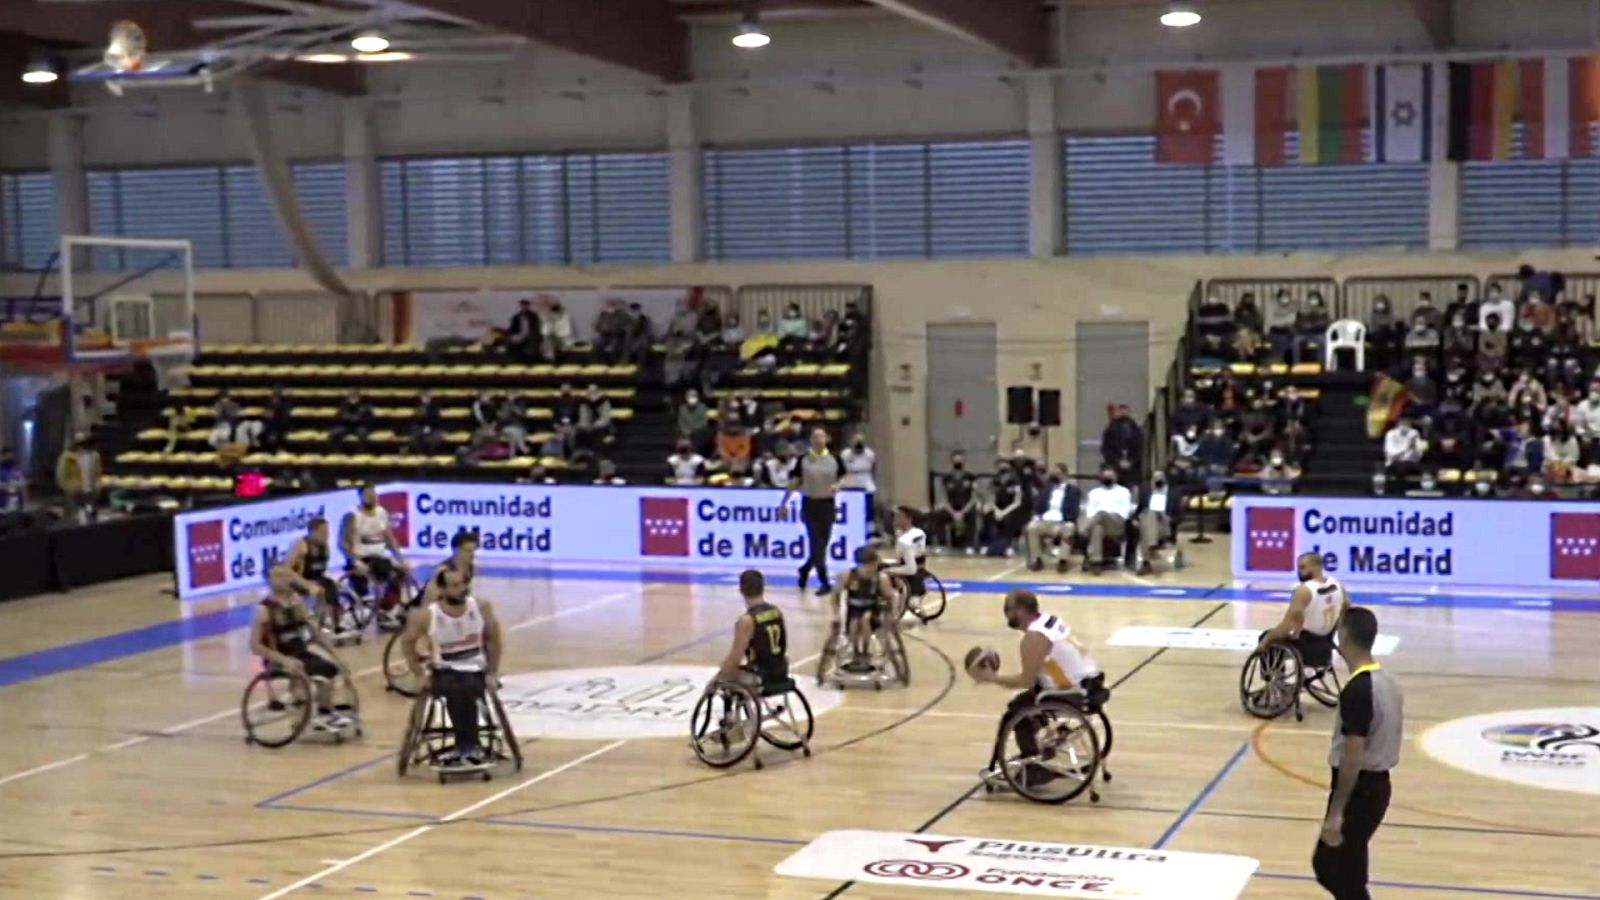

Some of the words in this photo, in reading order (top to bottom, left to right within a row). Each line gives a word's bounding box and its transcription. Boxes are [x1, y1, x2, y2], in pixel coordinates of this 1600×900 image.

[416, 493, 551, 517] Comunidad
[698, 499, 847, 525] Comunid
[1304, 508, 1453, 536] Comunidad
[417, 524, 448, 549] de
[698, 533, 733, 558] de
[744, 533, 847, 561] Madd
[231, 553, 256, 580] de
[1349, 546, 1452, 576] Madrid
[766, 624, 782, 656] 12
[976, 841, 1168, 863] PlusUltra
[975, 874, 1111, 893] ONCE
